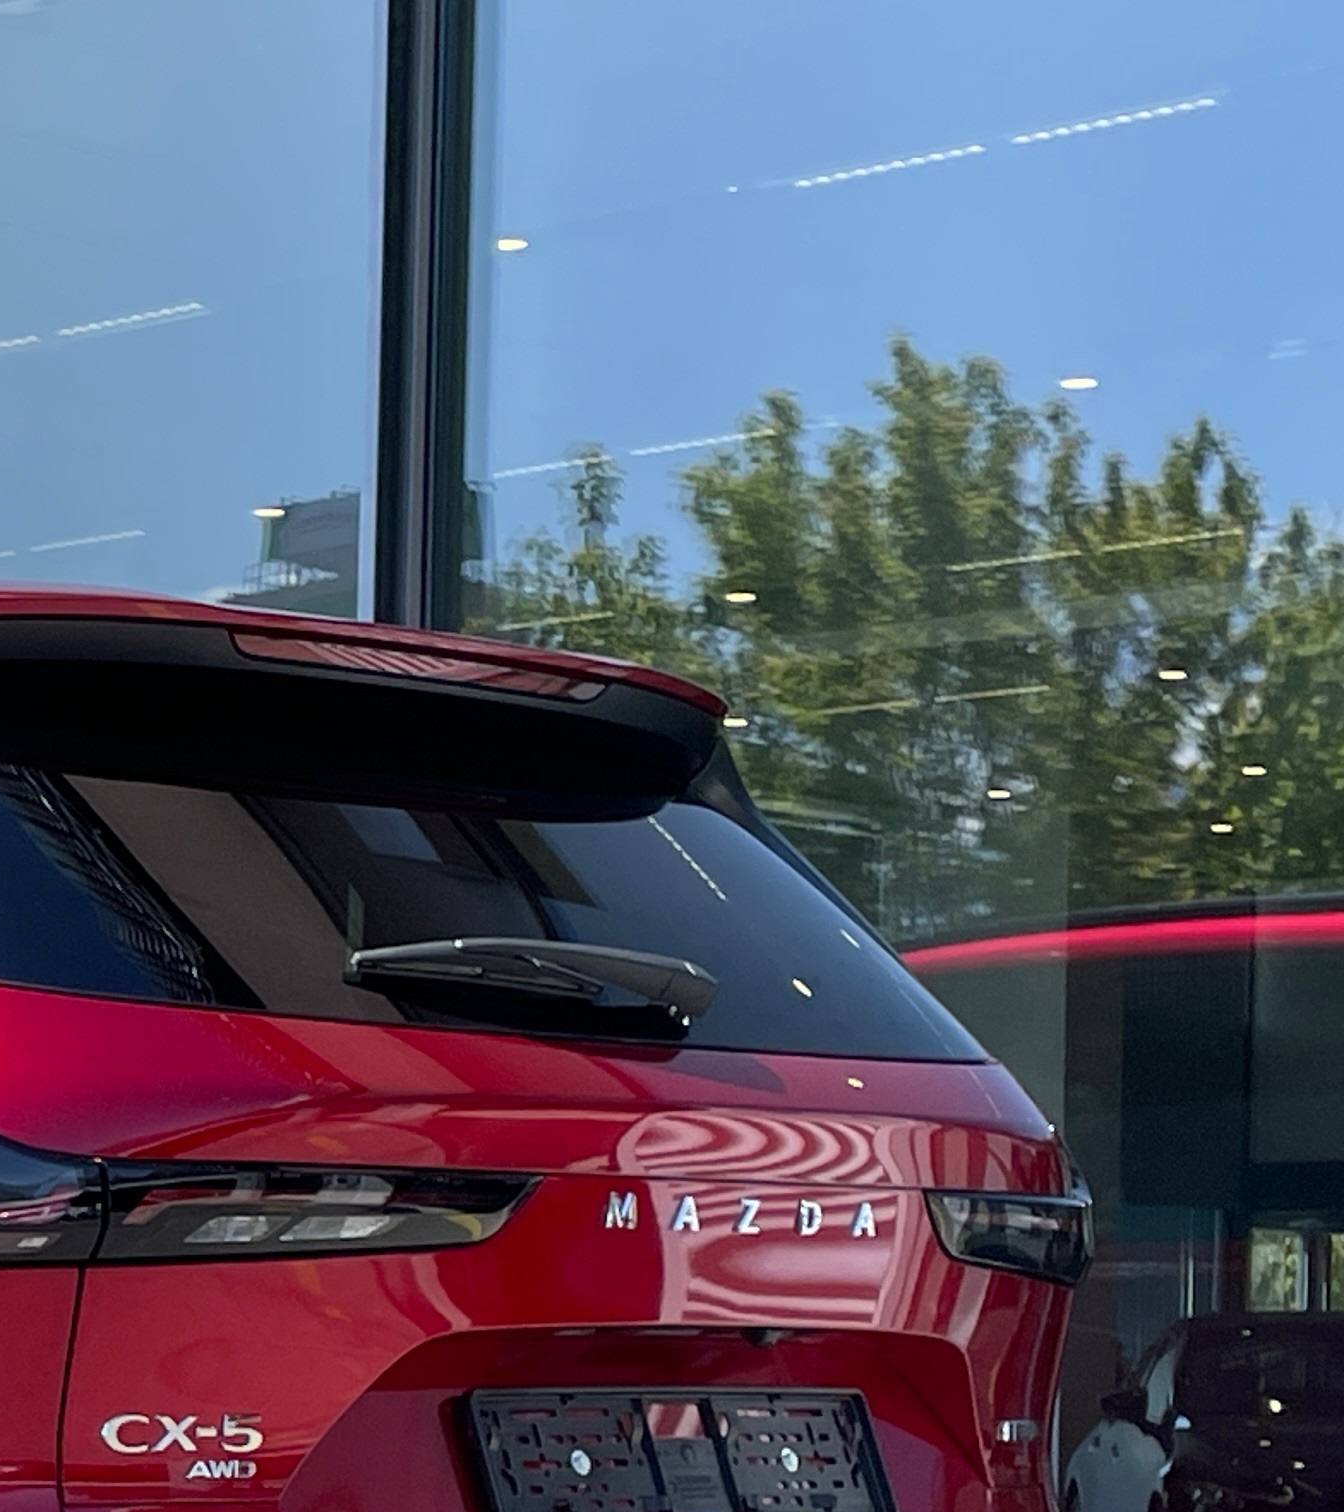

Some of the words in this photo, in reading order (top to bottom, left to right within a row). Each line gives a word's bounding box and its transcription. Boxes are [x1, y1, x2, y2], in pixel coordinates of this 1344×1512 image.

[604, 1191, 877, 1237] MAZDA
[100, 1414, 264, 1454] CX-5
[186, 1459, 258, 1479] AWD
